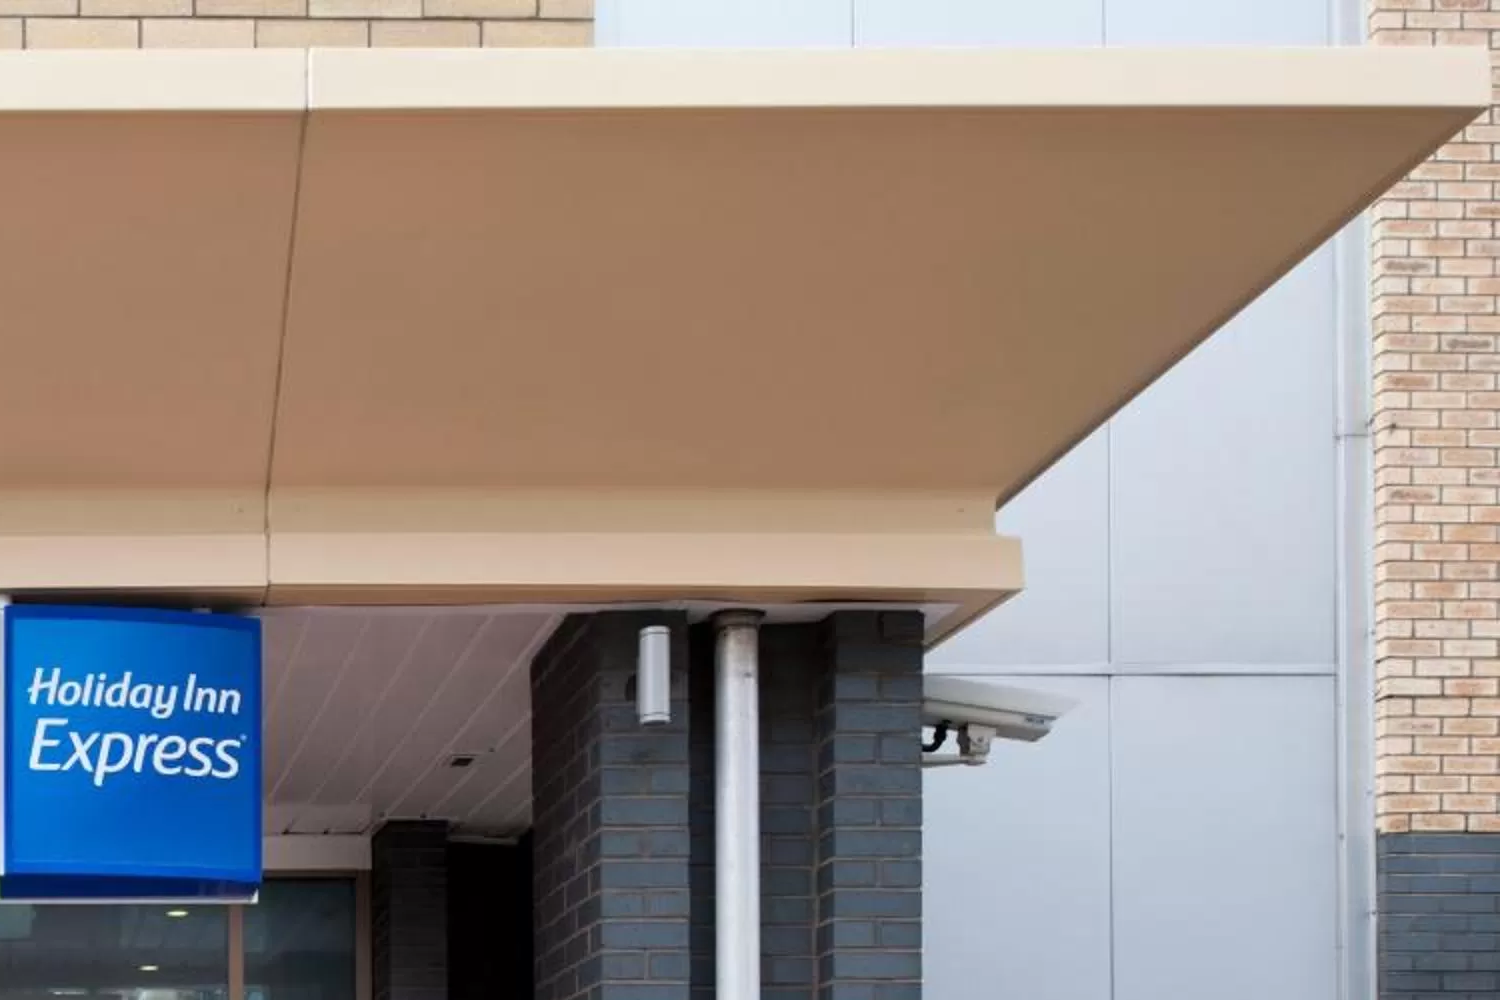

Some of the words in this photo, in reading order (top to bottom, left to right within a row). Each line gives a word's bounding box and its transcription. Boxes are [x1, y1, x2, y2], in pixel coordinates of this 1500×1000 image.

[27, 666, 178, 719] Holiday
[184, 673, 241, 714] Inn
[29, 718, 242, 787] Express
